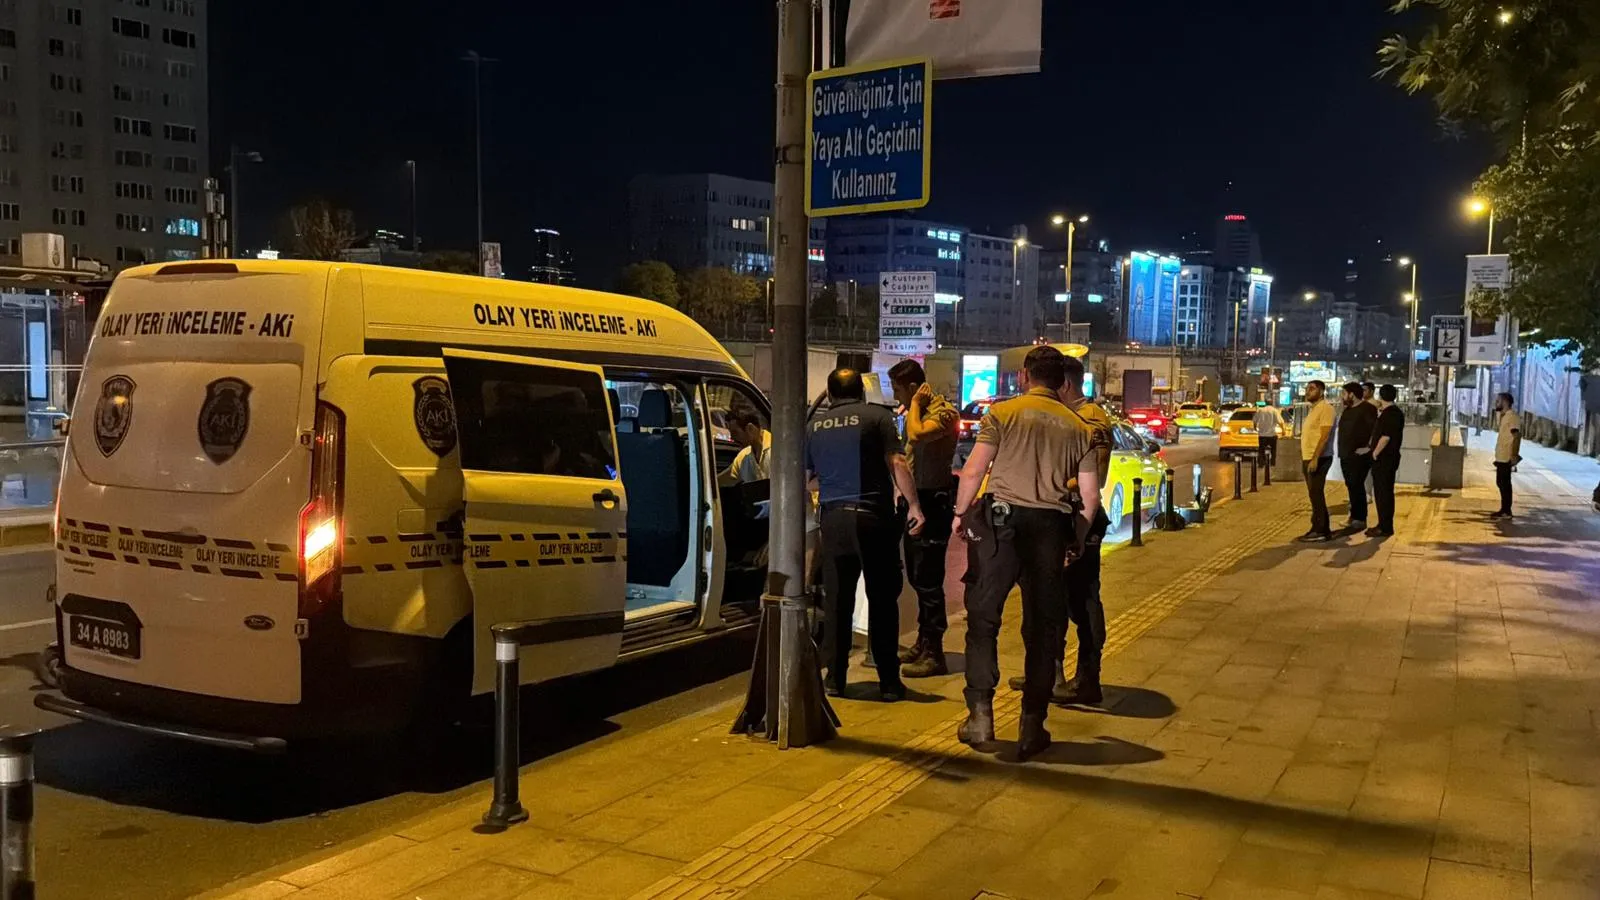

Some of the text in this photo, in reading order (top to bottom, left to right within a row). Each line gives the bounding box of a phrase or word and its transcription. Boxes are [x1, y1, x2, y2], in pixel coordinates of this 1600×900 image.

[813, 68, 922, 119] Güvenliğiniz İçin
[812, 119, 921, 168] Yaya Alt Geçidini
[831, 168, 897, 200] Kullanınız
[101, 313, 132, 337] OLAY
[473, 303, 515, 327] OLAY
[883, 342, 917, 350] Taksim
[118, 537, 133, 551] OLAY
[196, 547, 216, 562] OLAY
[410, 543, 433, 558] OLAY
[540, 543, 557, 556] OLAY
[77, 622, 90, 642] 34
[92, 625, 101, 644] A
[102, 627, 130, 650] 8983
